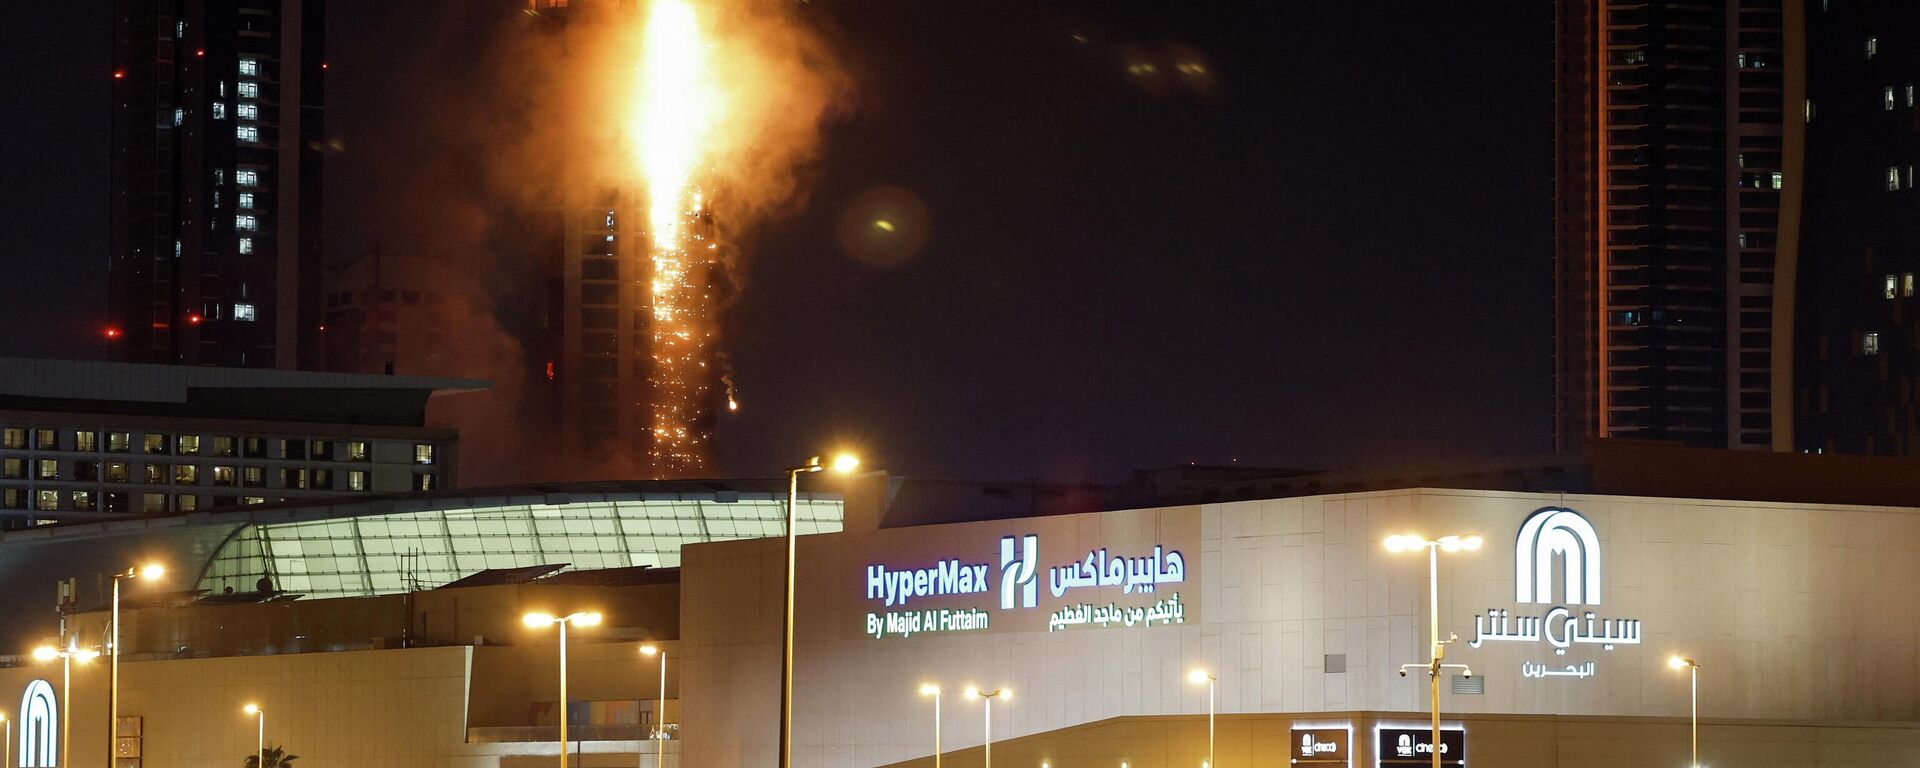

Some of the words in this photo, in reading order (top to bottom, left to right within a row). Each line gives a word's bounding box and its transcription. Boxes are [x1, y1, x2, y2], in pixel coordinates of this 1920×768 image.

[867, 560, 988, 607] HyperMax
[1049, 545, 1184, 597] هايبرماكس
[867, 613, 884, 639] By
[886, 611, 921, 638] Majid
[923, 611, 937, 631] Al
[940, 608, 988, 630] Futtaim
[1049, 604, 1092, 632] الفطيم
[1093, 603, 1122, 629] ماجد
[1124, 605, 1143, 628] من
[1468, 608, 1541, 648] سنتر
[1544, 606, 1641, 655] سيتي
[1522, 661, 1595, 678] البحرين
